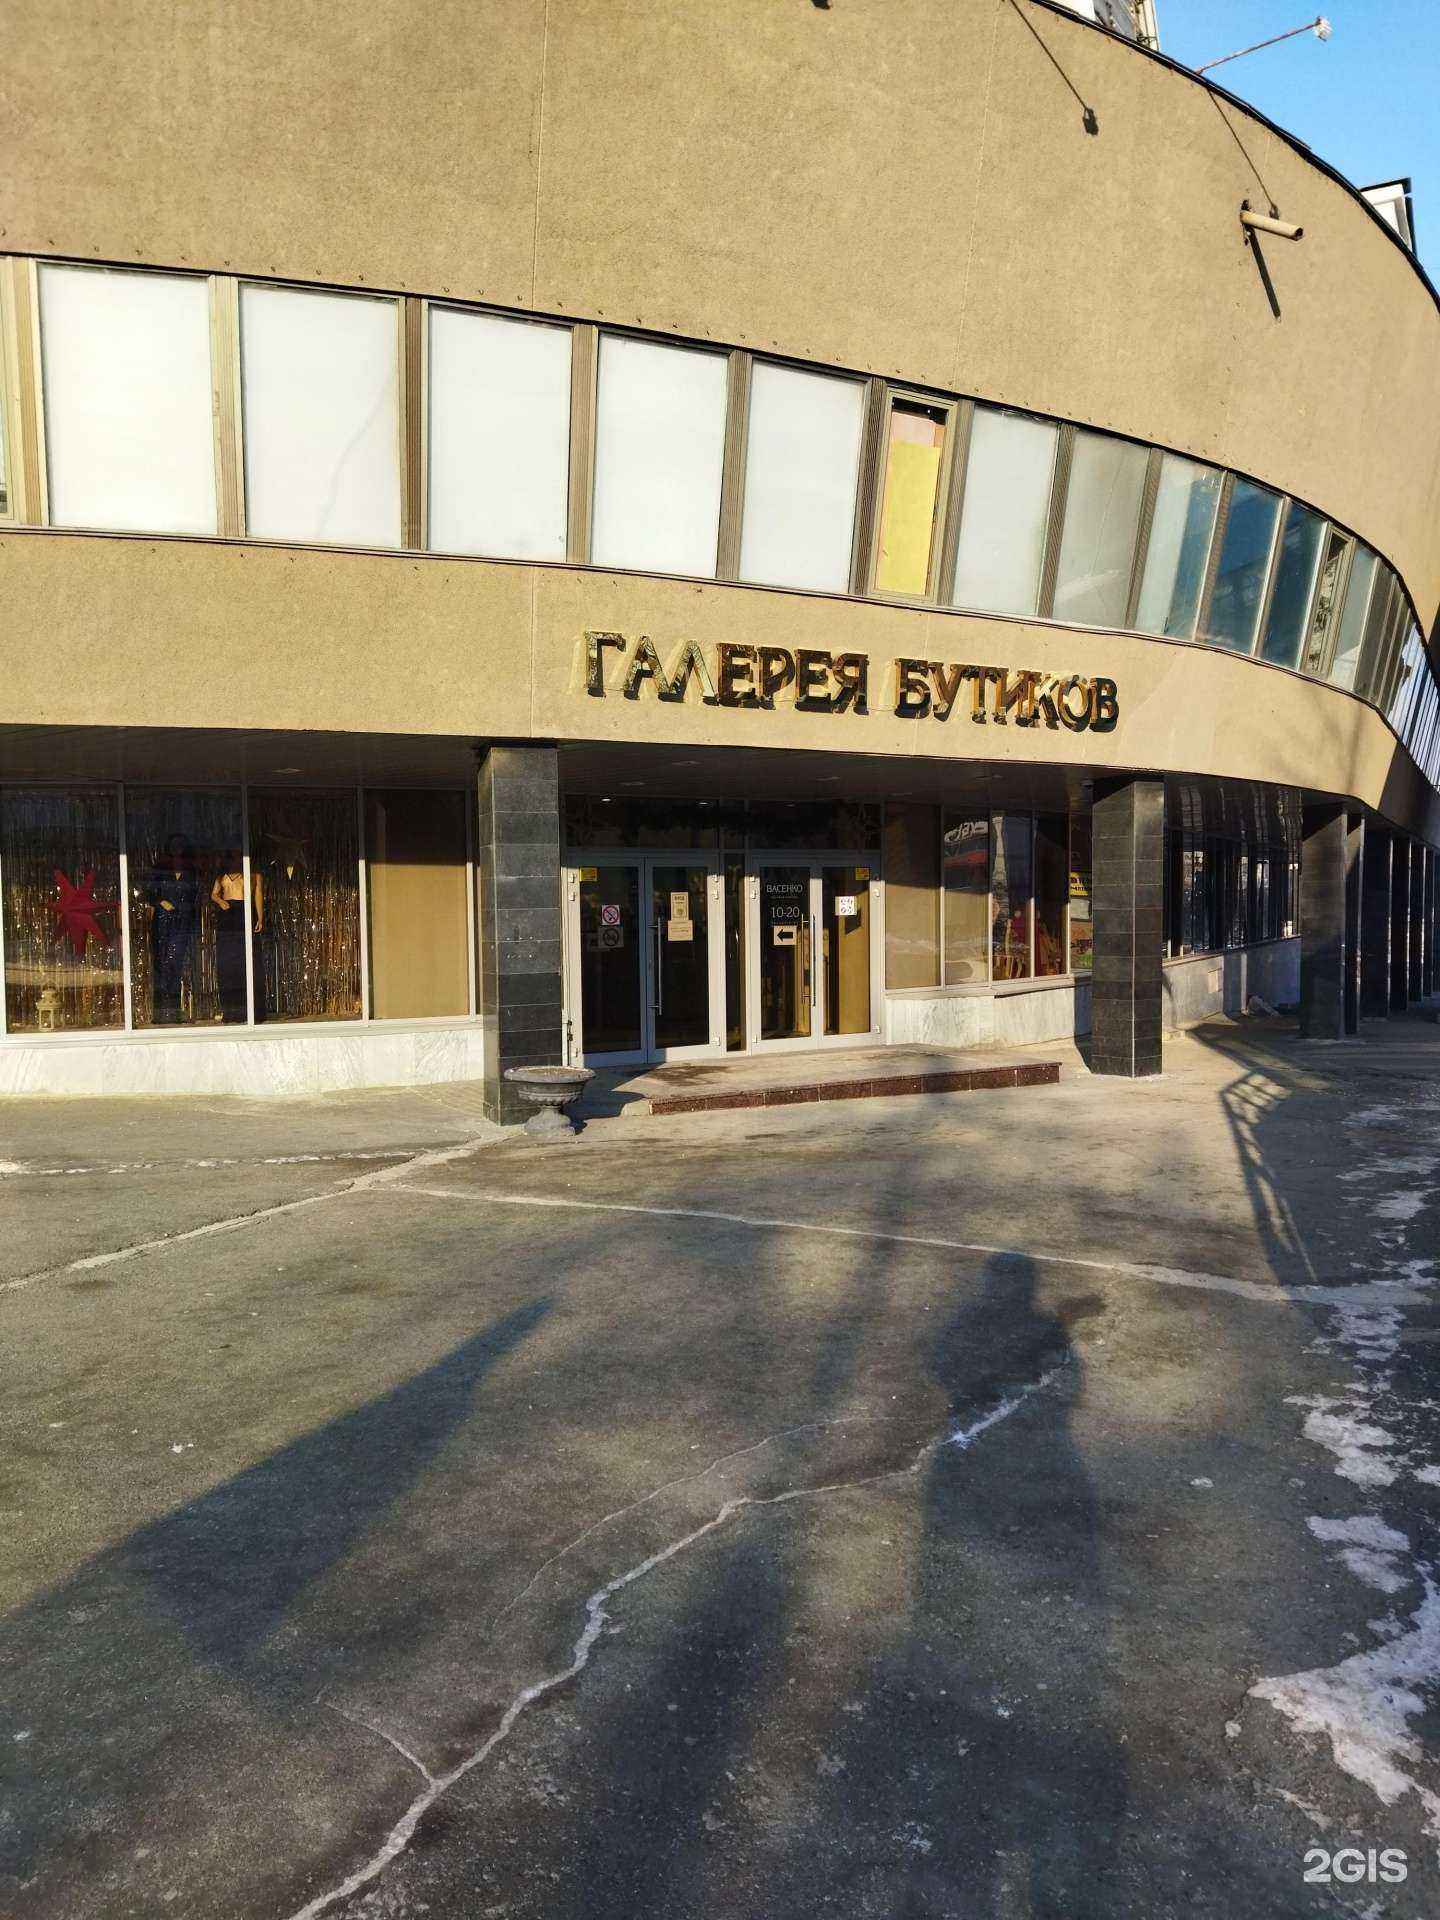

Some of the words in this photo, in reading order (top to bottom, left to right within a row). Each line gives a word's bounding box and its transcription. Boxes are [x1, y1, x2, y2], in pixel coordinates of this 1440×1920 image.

[584, 630, 870, 714] ГАЛЕРЕЯ
[894, 657, 1120, 733] БУТИКОВ
[771, 906, 800, 918] 10-20
